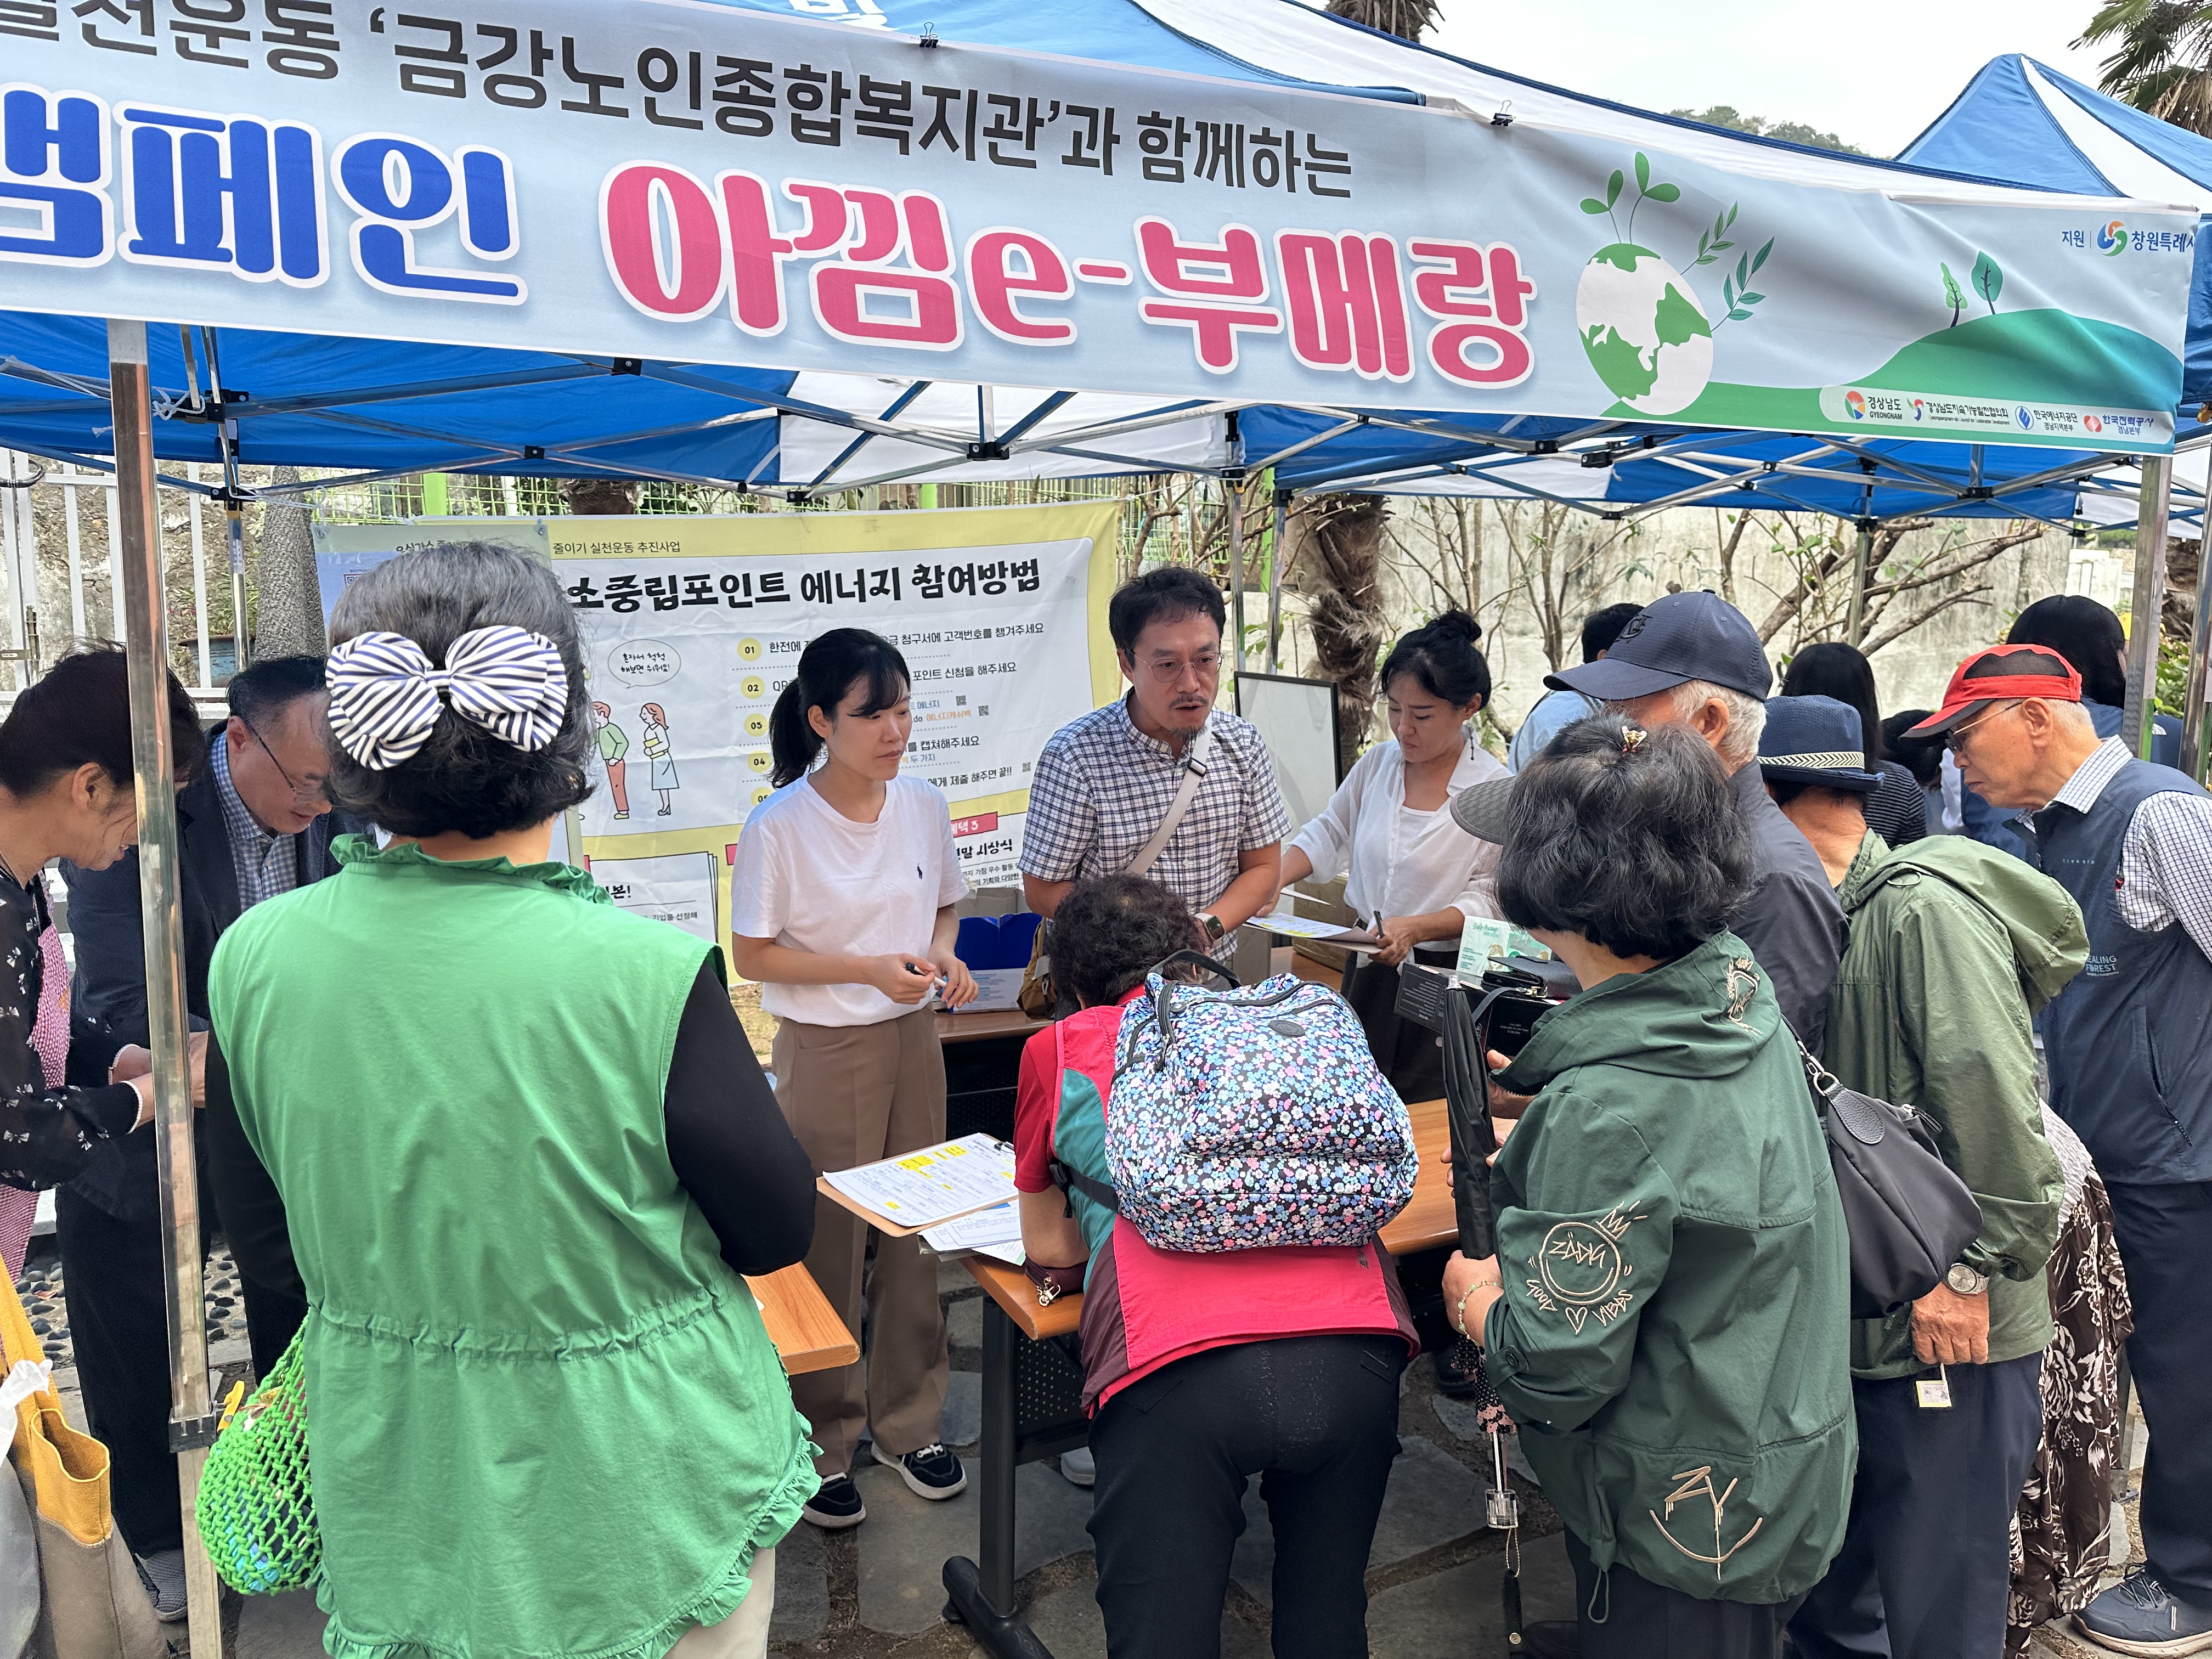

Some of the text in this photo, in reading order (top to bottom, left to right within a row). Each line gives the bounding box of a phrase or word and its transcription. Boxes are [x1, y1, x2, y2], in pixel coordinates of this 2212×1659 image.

[369, 7, 1120, 176] ‘금강노인종합복지관’과
[1137, 110, 1351, 198] 함께하는
[2061, 230, 2084, 247] 지원
[603, 163, 1534, 386] 아낌e-부메랑
[1867, 396, 1901, 410] 경상남도
[1926, 402, 2009, 418] 경상남도지속가능발전협의회
[1870, 411, 1903, 420] GYEONGNAM
[2033, 409, 2078, 423] 한국에너지공단
[2102, 414, 2154, 427] 한국전력공사
[2044, 422, 2074, 432] 경남지역본부
[2118, 425, 2141, 436] 경남본부
[552, 541, 680, 554] 줄이기 실천운동 추진사업
[800, 567, 901, 604] 에너지
[912, 558, 1040, 599] 참여방법
[769, 641, 802, 653] 한전에
[901, 632, 941, 645] 청구서에
[944, 628, 992, 642] 고객번호를
[995, 623, 1044, 637] 챙겨주세요
[623, 653, 645, 663] 혼자서
[620, 665, 644, 674] 해보면
[912, 669, 942, 681] 포인트
[945, 666, 974, 679] 신청을
[977, 662, 1017, 675] 해주세요
[917, 700, 940, 709] 에너지
[921, 735, 980, 751] 캡쳐해주세요
[910, 755, 918, 763] 두
[920, 753, 936, 763] 가지
[971, 769, 997, 783] 해주면
[999, 766, 1012, 777] 끝!!
[977, 838, 1013, 856] 시상식
[989, 865, 1000, 873] 우수
[2085, 963, 2116, 973] FOREST
